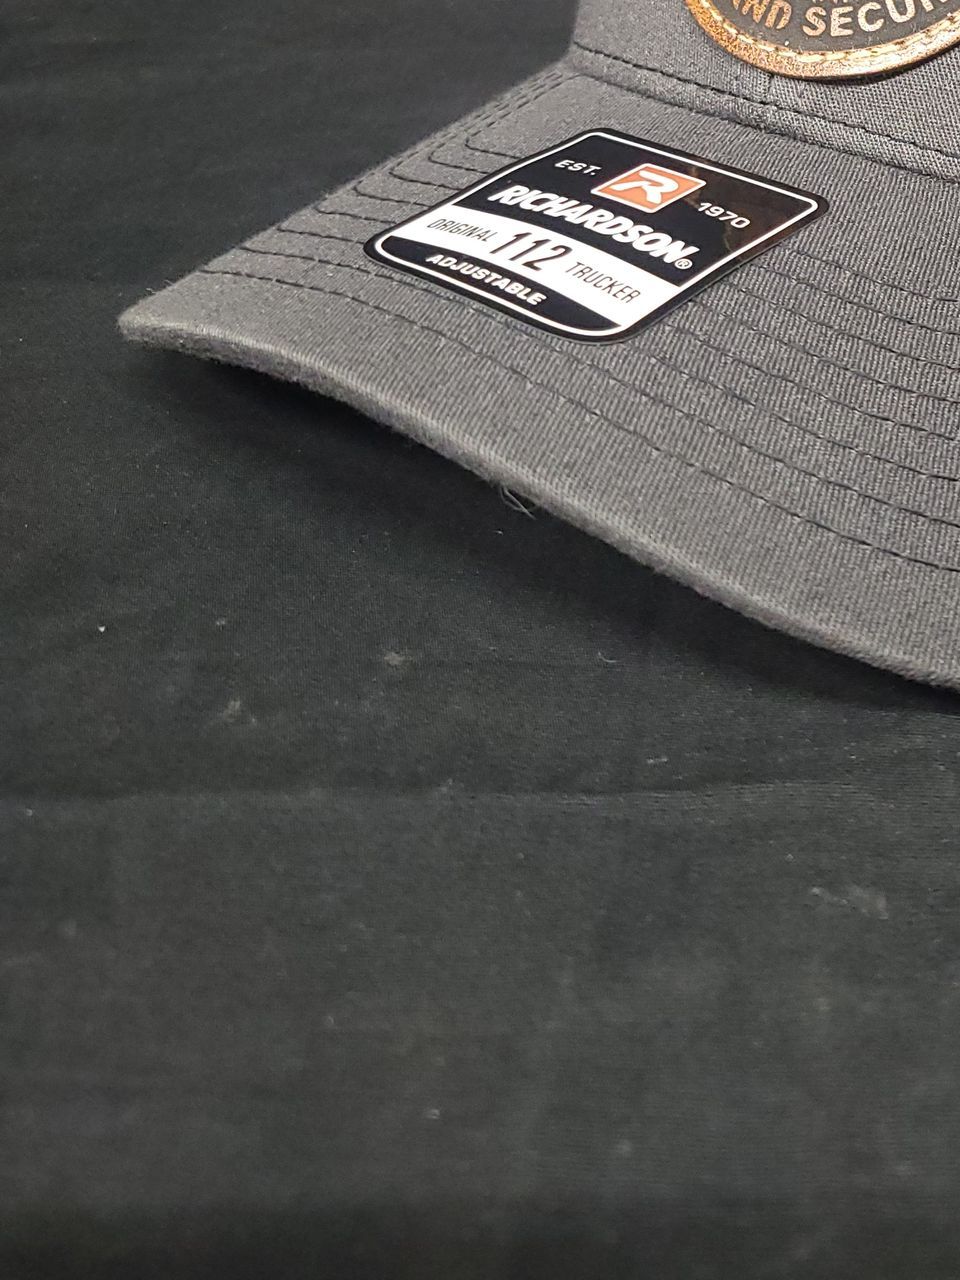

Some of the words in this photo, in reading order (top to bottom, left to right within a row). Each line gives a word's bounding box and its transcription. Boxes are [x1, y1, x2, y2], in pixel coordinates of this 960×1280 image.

[554, 159, 601, 177] EST.
[698, 201, 751, 230] 1970
[425, 253, 547, 306] ADJUSTABLE
[427, 218, 491, 244] ORIGINAL
[489, 232, 573, 273] 112
[564, 261, 642, 305] TRUCKER
